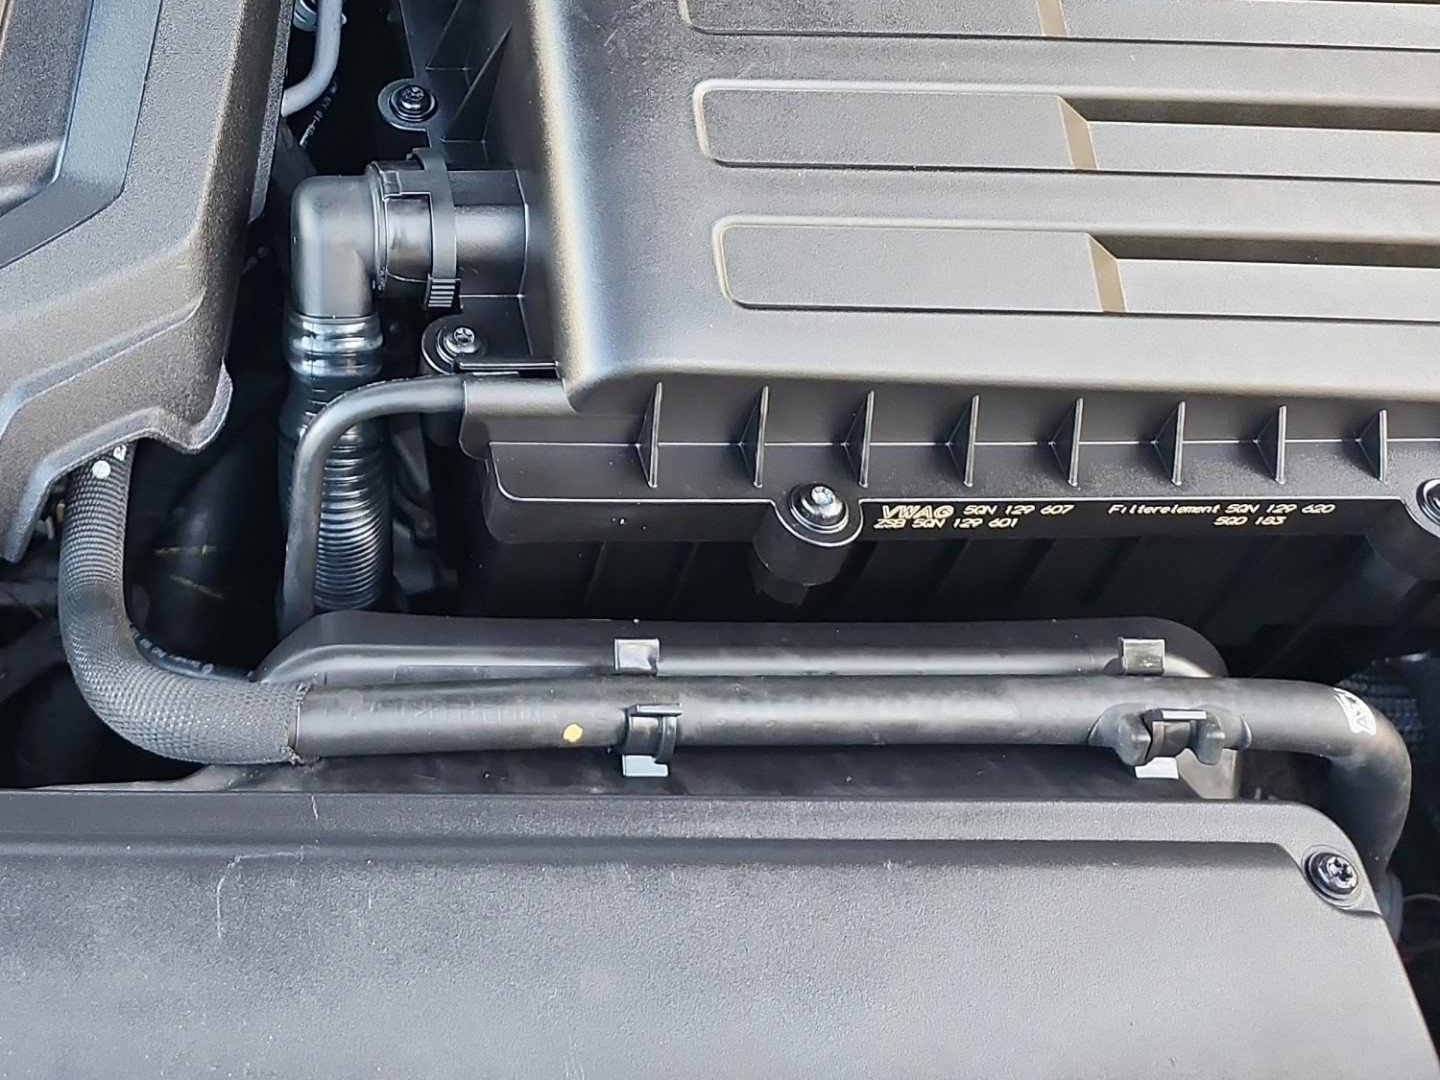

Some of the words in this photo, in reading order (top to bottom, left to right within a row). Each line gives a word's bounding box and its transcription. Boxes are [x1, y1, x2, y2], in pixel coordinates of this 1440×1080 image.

[963, 505, 998, 516] 5QN
[1005, 505, 1036, 516] 129
[1040, 505, 1075, 516] 607
[1108, 504, 1221, 515] Filterelement
[1224, 504, 1261, 514] 5QN
[1266, 504, 1298, 514] 129
[1301, 504, 1336, 514] 620
[911, 519, 946, 529] 5QN
[953, 518, 984, 529] 129
[988, 518, 1019, 529] 601
[1254, 516, 1287, 526] 183
